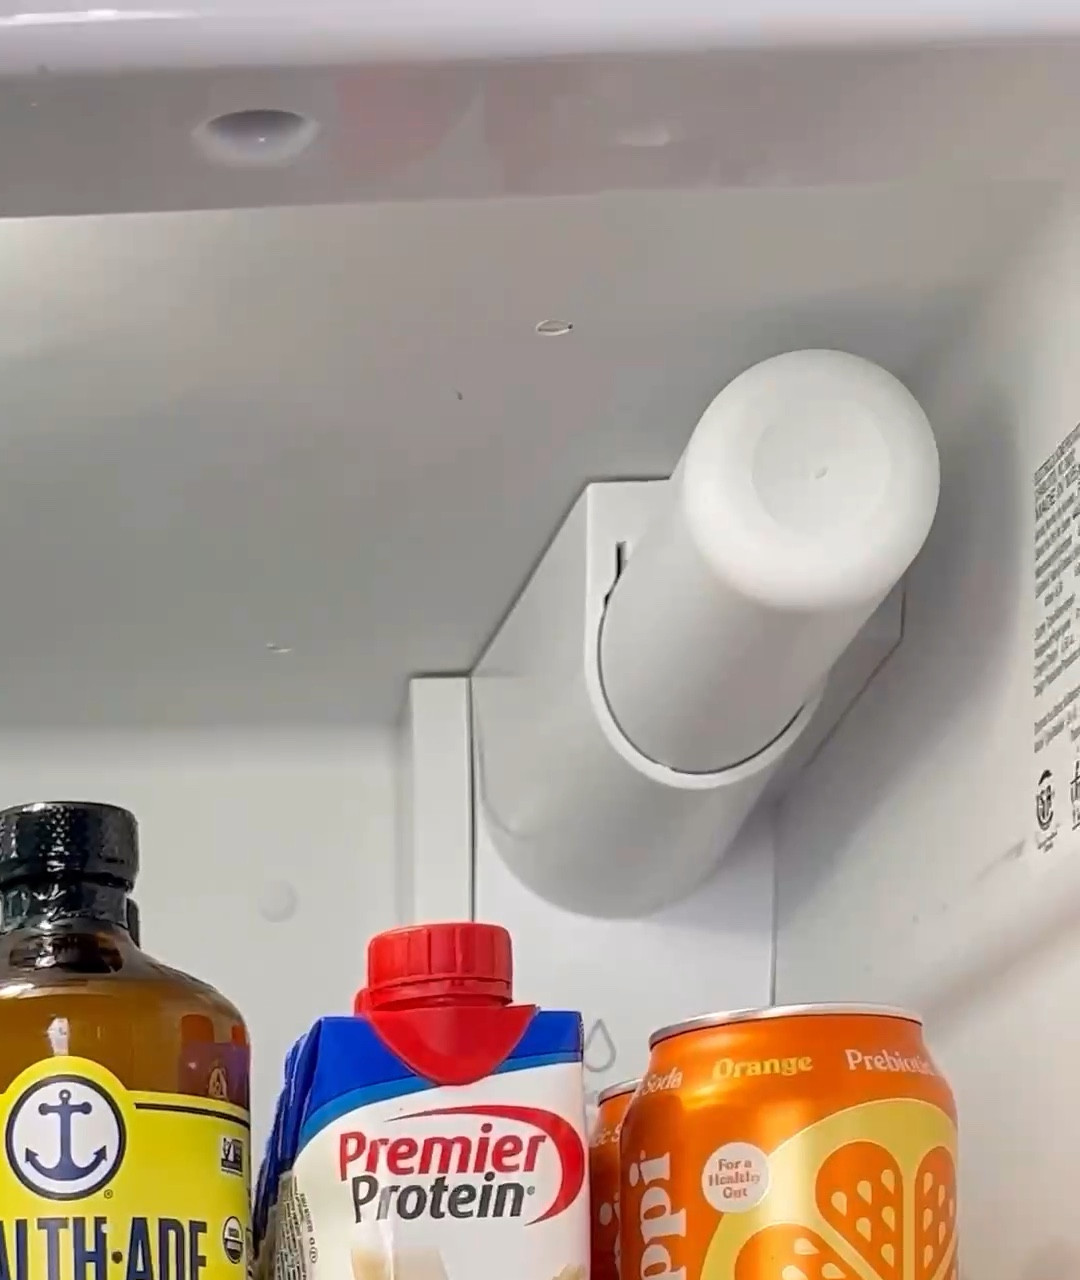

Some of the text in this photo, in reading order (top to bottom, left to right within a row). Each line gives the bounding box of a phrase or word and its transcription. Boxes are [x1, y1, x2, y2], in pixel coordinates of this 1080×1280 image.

[712, 1055, 813, 1080] Orange
[338, 1122, 548, 1182] Premier
[718, 1158, 752, 1171] For a
[708, 1170, 760, 1187] Healthy
[351, 1170, 526, 1225] Protein
[722, 1186, 748, 1199] Gut
